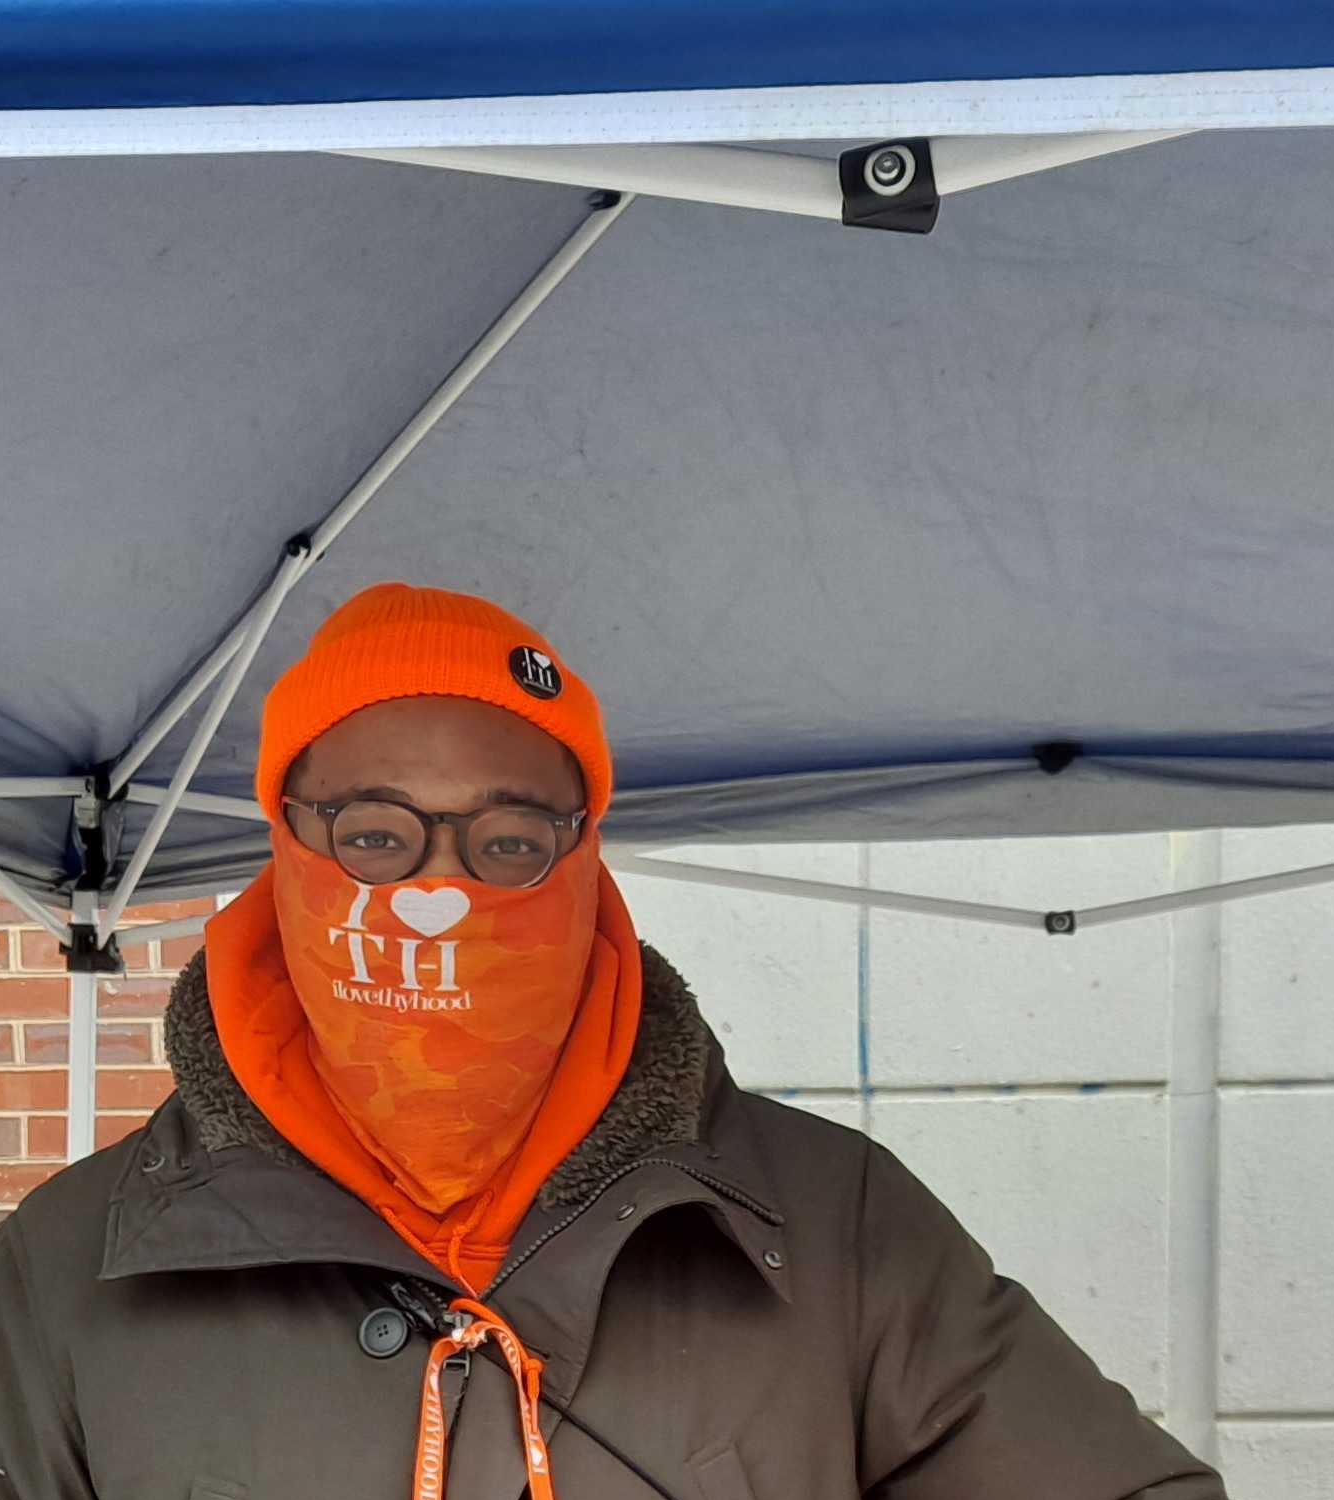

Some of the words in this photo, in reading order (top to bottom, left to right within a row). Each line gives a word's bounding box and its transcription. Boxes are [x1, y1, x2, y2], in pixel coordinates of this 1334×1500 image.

[341, 881, 374, 931] I
[328, 927, 461, 991] TH
[332, 979, 472, 1013] ilovethyhood
